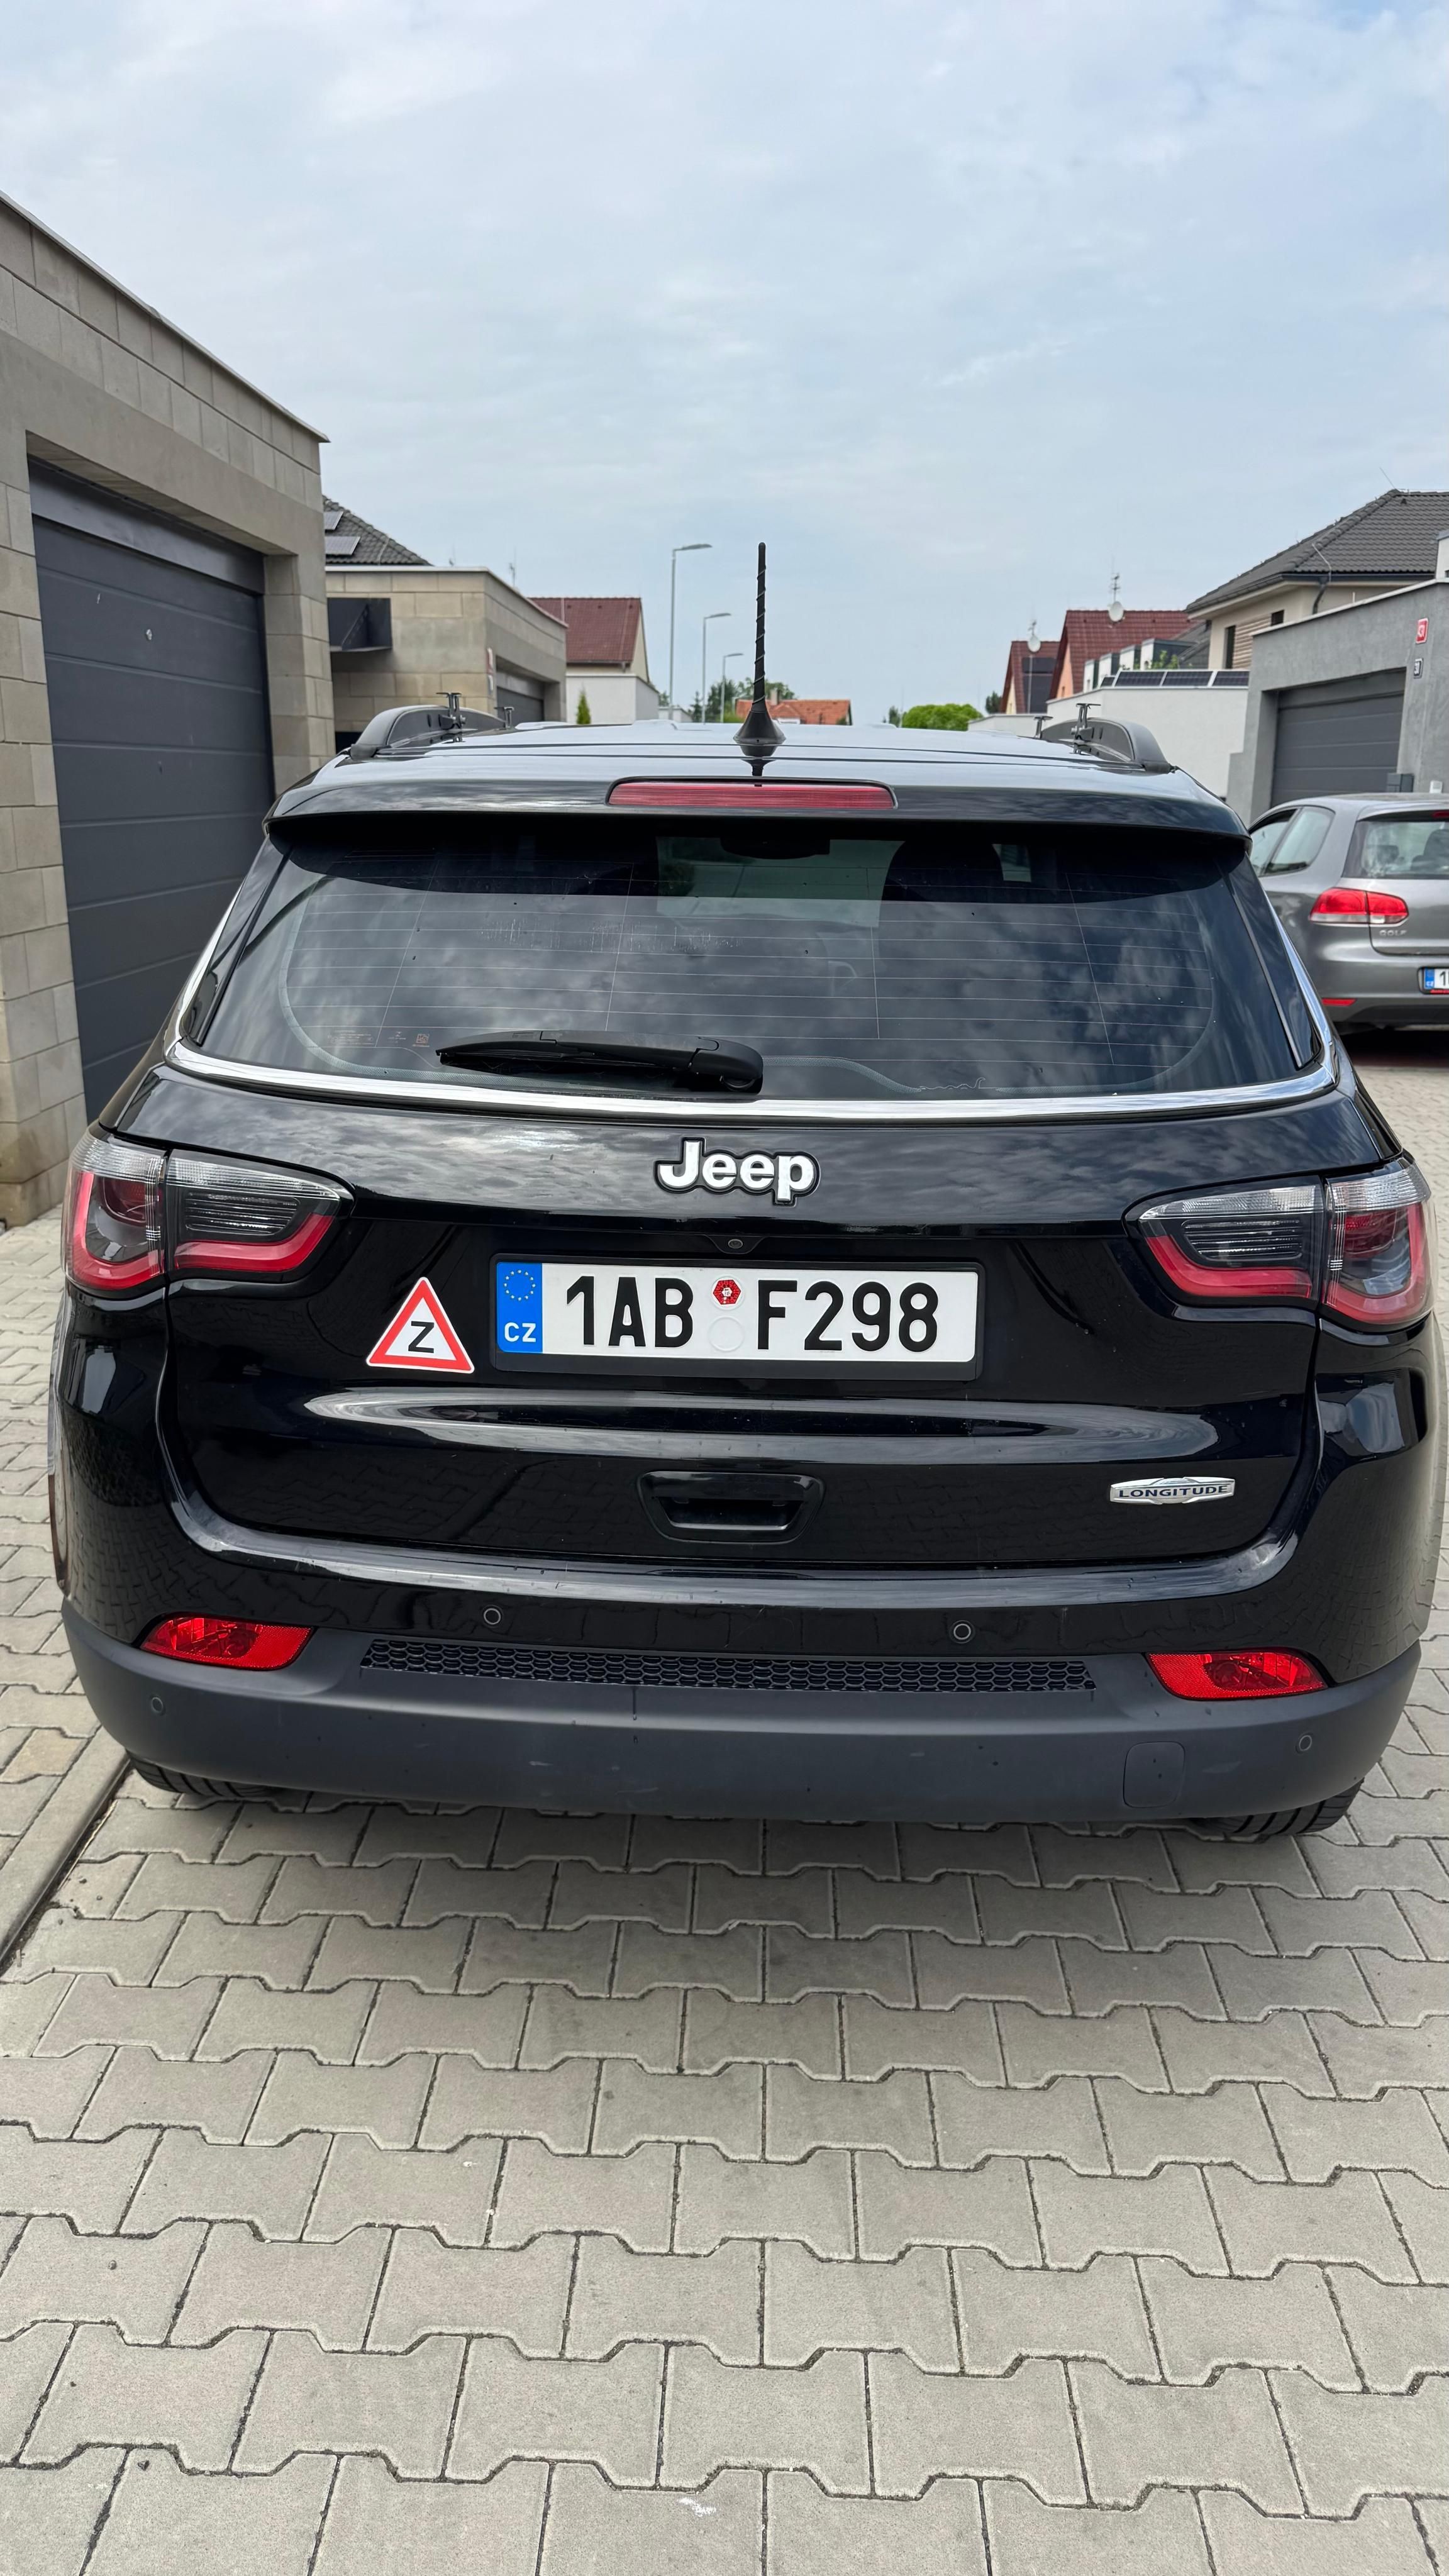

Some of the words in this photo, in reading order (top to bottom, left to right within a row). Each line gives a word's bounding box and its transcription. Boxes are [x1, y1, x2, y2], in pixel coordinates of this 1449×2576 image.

[658, 1140, 815, 1201] Jeep
[566, 1275, 694, 1348] 1AB
[757, 1279, 939, 1353] F298
[408, 1321, 435, 1353] Z
[504, 1321, 536, 1343] CZ
[1119, 1485, 1228, 1497] LONGITUDE
